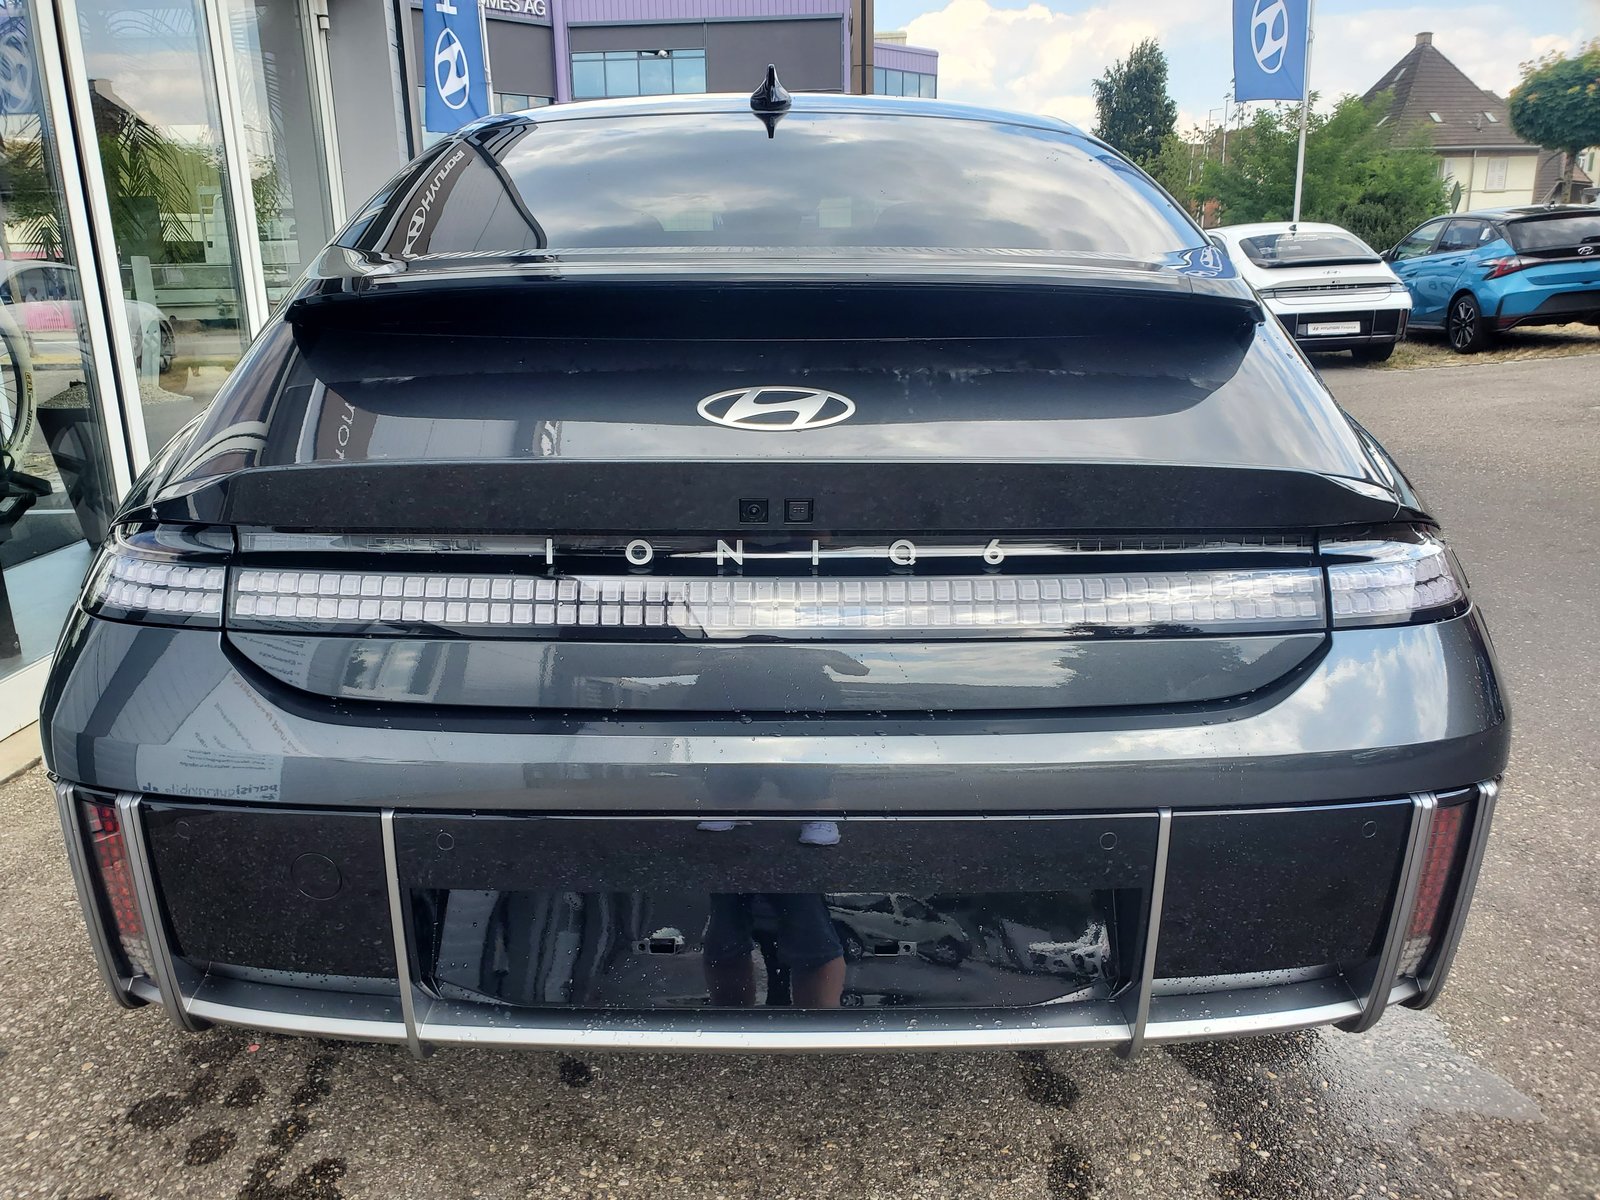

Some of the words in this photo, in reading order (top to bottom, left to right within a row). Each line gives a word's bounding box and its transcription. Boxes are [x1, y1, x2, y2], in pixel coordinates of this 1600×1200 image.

[482, 0, 520, 12] MES
[523, 0, 546, 16] AG
[546, 538, 917, 566] IONIQ
[983, 538, 1005, 565] 6
